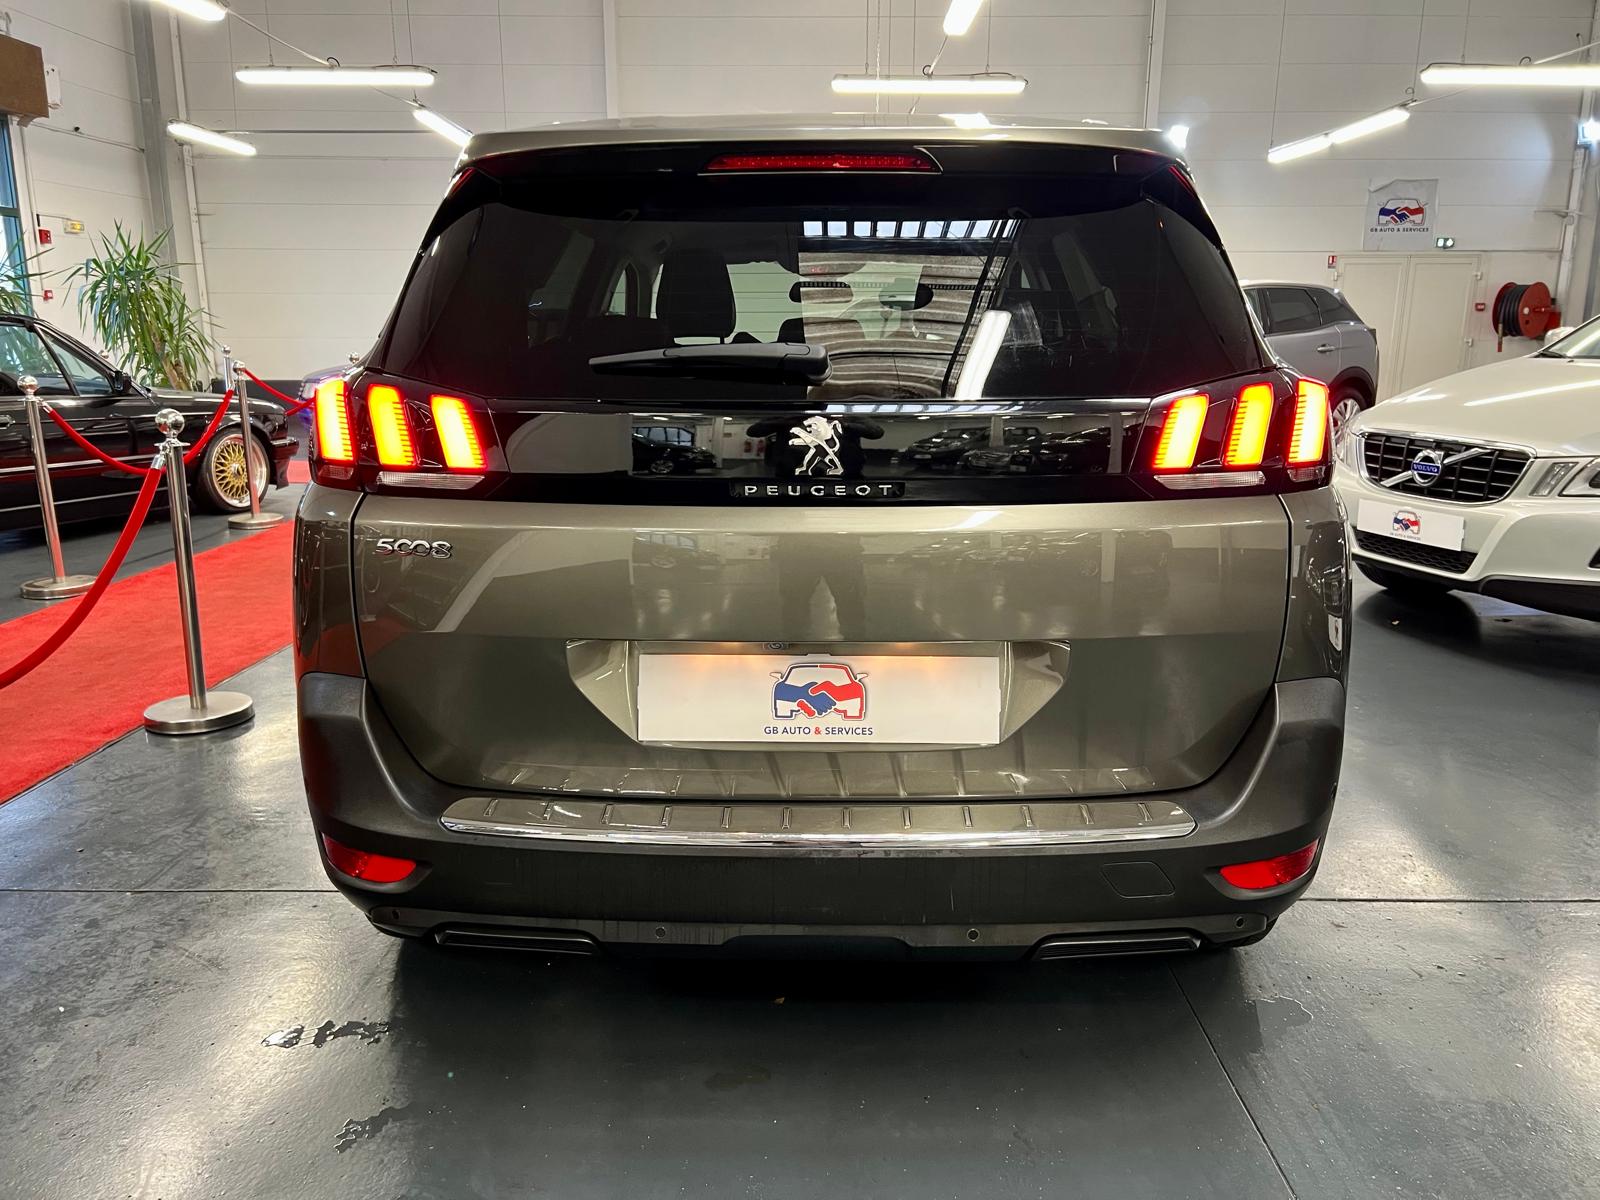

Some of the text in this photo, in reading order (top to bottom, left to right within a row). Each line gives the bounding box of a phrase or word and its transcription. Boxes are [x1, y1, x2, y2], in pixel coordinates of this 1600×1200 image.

[1413, 463, 1438, 473] VOLVO
[744, 485, 892, 496] PEUGEOT
[375, 538, 452, 559] 5008
[763, 726, 873, 736] GB AUTO & SERVICES
